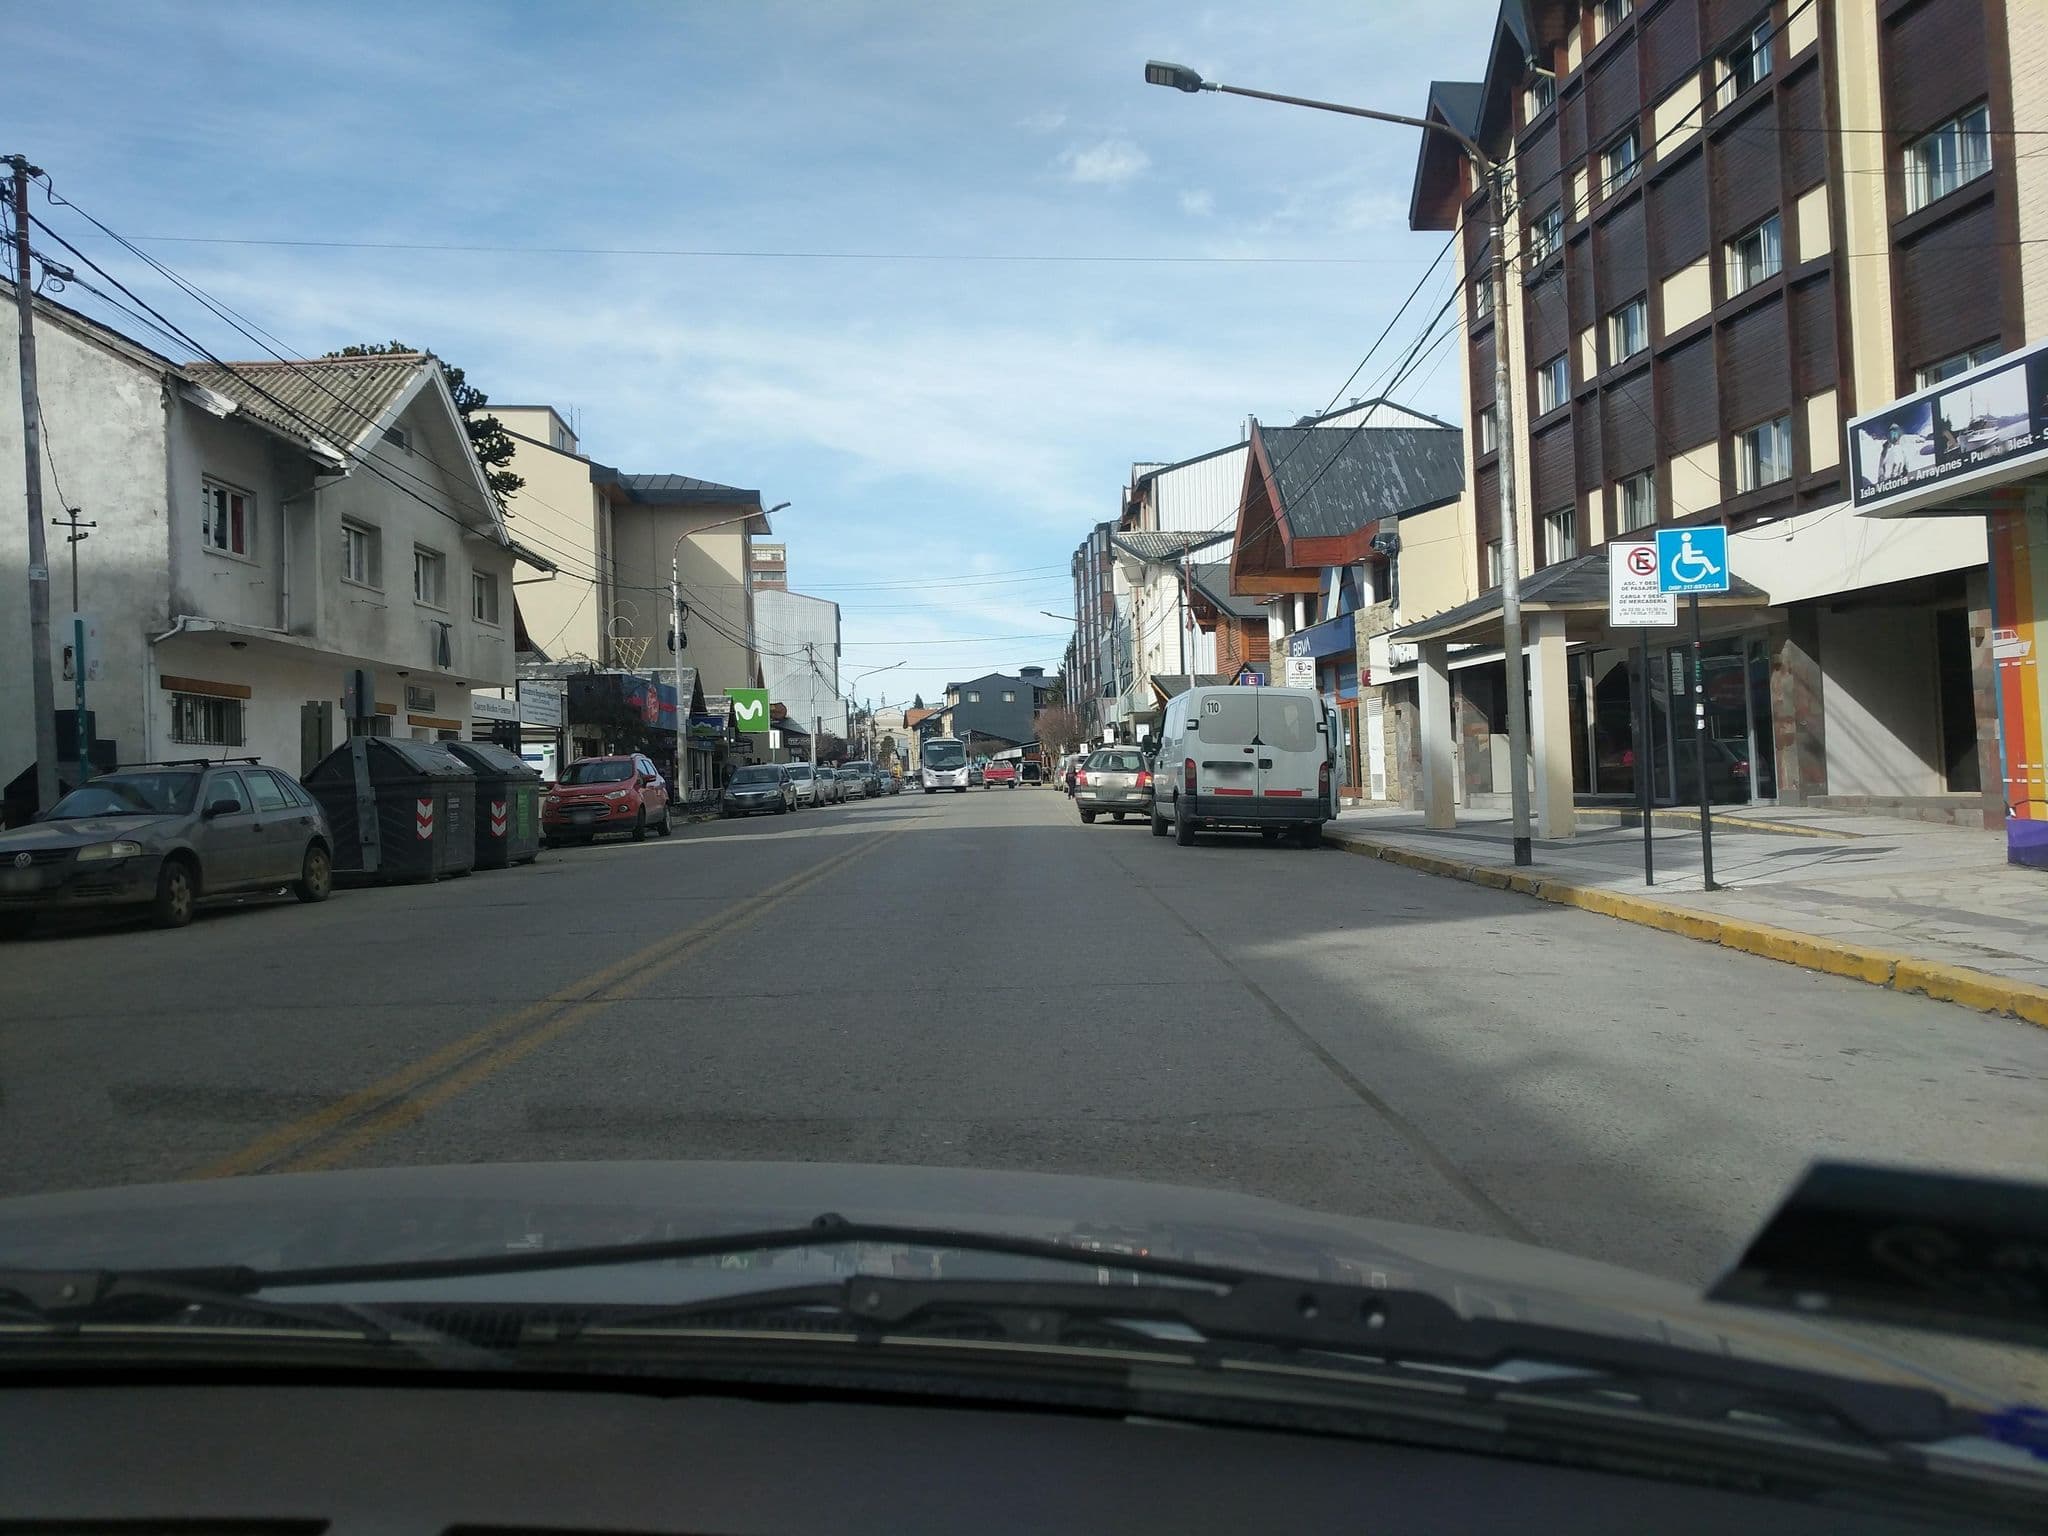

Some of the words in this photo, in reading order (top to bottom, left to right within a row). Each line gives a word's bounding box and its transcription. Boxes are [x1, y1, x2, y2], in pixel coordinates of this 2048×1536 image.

[1860, 485, 1875, 499] Isla
[1876, 473, 1909, 494] Victoria
[1916, 458, 1962, 482] Arrayanes
[1293, 636, 1311, 657] BBVA
[1206, 702, 1220, 714] 110
